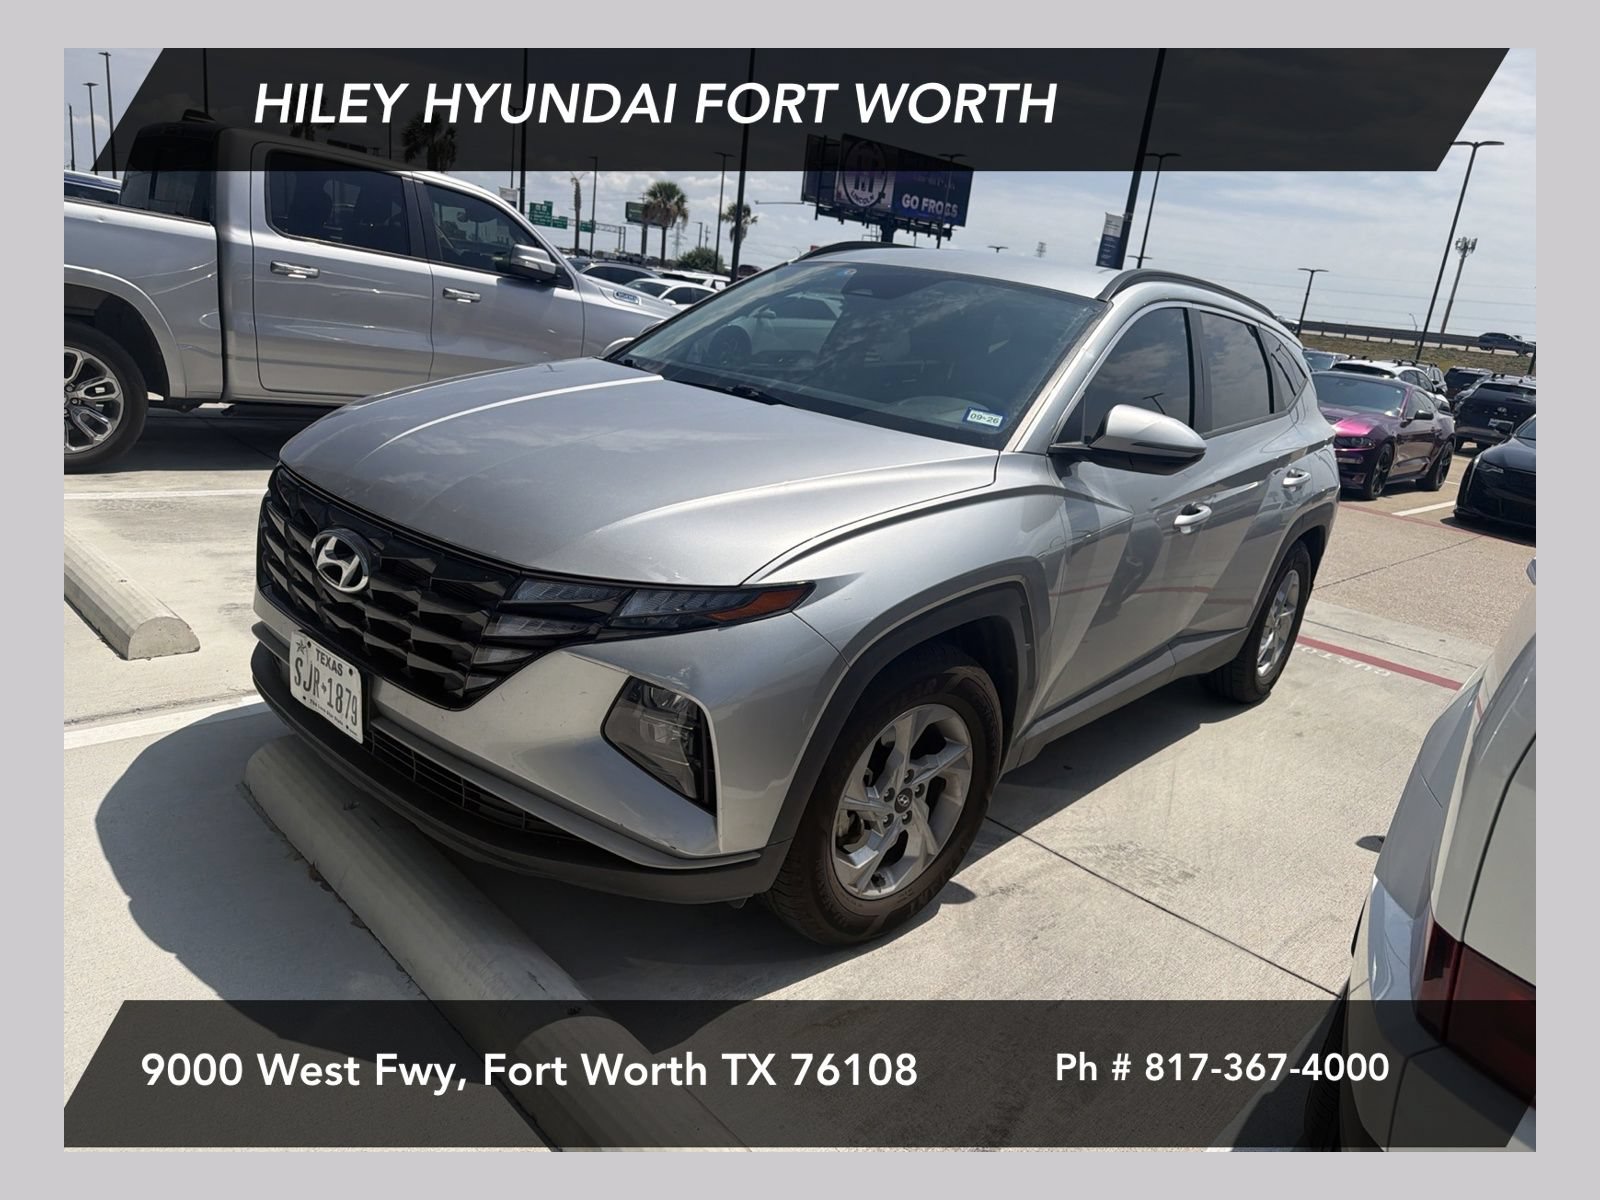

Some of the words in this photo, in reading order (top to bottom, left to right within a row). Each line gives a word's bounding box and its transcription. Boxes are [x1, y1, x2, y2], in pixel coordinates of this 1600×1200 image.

[850, 189, 875, 205] LINCOLN
[902, 193, 919, 210] GO
[921, 197, 958, 218] FROGS
[315, 648, 343, 677] TEXAS
